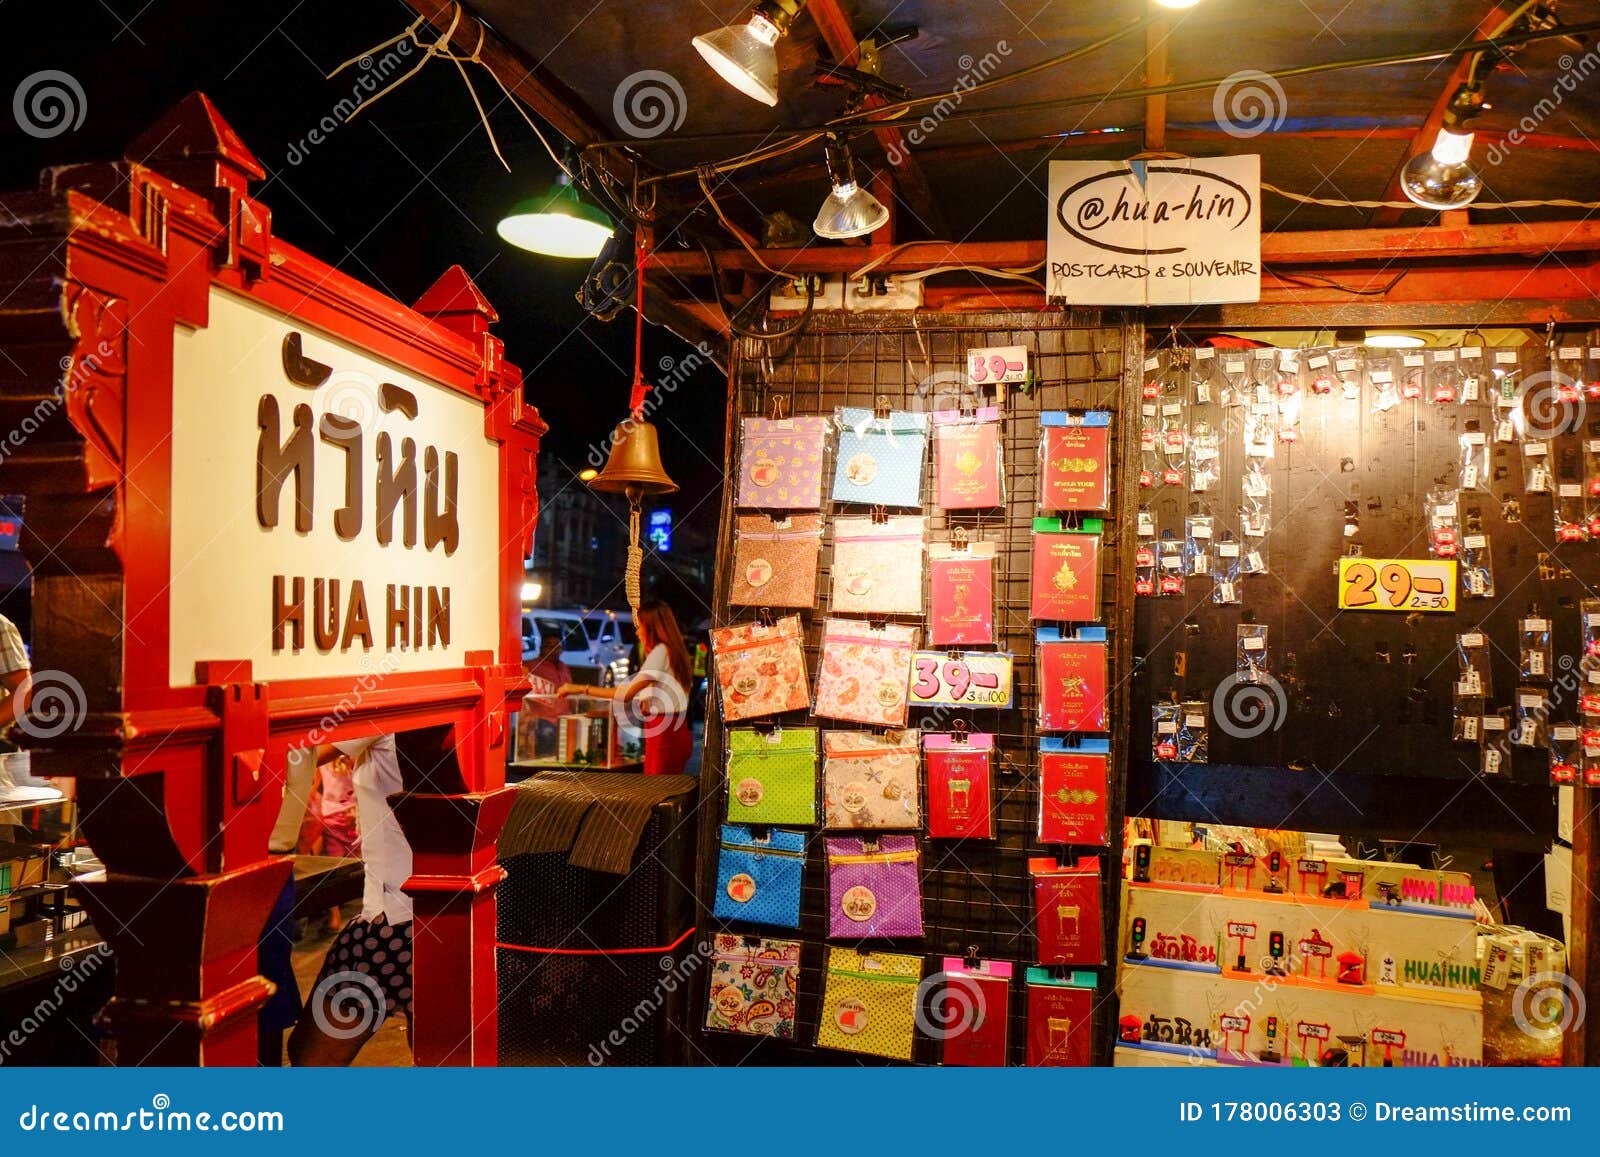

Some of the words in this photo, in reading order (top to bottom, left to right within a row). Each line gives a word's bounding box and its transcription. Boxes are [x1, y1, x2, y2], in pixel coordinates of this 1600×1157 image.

[1051, 262, 1150, 279] POSTCARD
[1155, 266, 1167, 277] &
[1172, 261, 1257, 277] SOUVENIR
[1344, 563, 1444, 608] 29-
[272, 575, 374, 652] HUA
[386, 583, 451, 652] HIN
[912, 658, 998, 700] 39-
[1402, 877, 1437, 903] HUA
[1442, 883, 1476, 907] HIN
[1404, 959, 1442, 982] HUA
[1448, 964, 1481, 987] HIN
